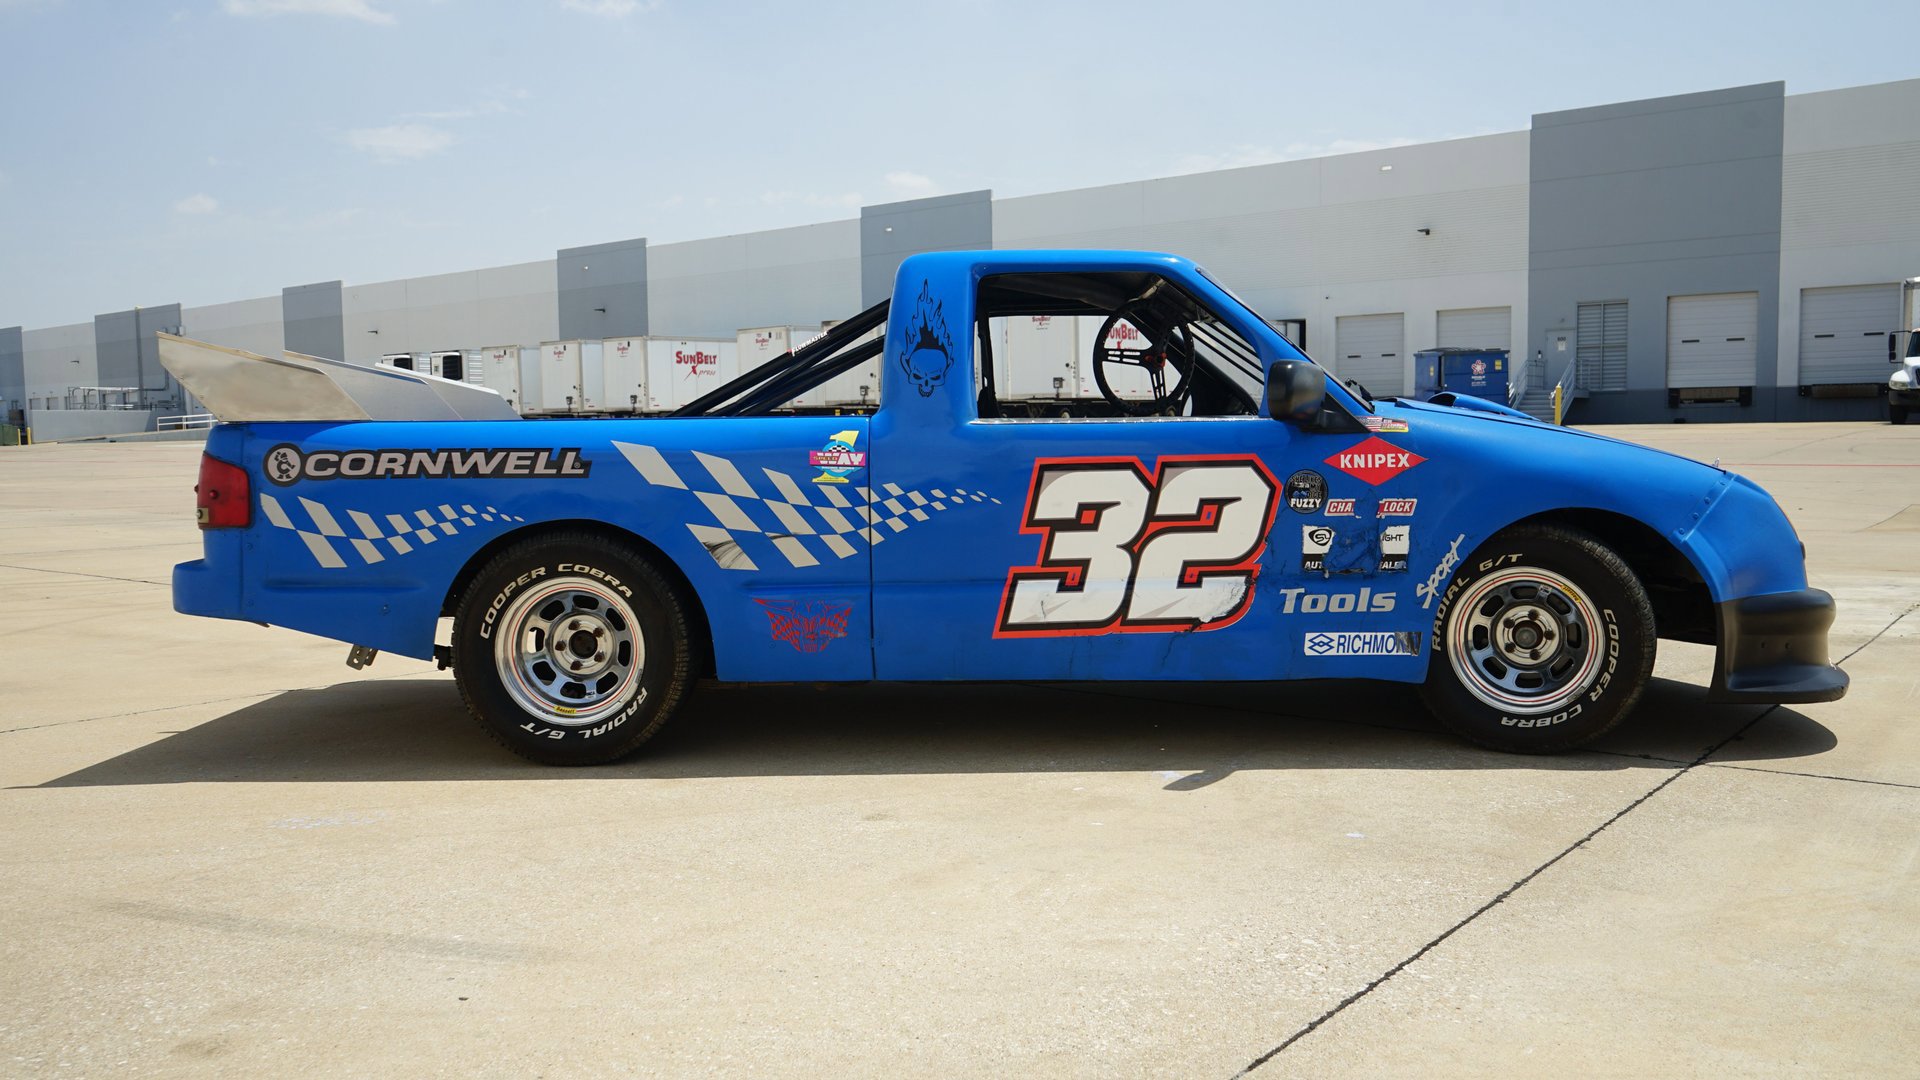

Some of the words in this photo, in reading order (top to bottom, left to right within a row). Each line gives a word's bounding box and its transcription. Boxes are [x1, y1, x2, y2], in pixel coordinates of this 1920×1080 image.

[791, 331, 828, 357] FLOWMASTER
[676, 351, 717, 365] SUNBELT
[304, 451, 585, 476] CORNWELL
[816, 452, 864, 465] WAY
[1340, 453, 1410, 469] KNIPEX
[1290, 498, 1322, 508] FUZZY
[1329, 502, 1354, 512] CHA
[1383, 501, 1412, 512] LOCK
[996, 457, 1281, 637] 32
[480, 566, 547, 640] COOPER
[557, 563, 633, 598] COBRA
[1279, 587, 1397, 614] Tools
[1431, 576, 1471, 651] RADIAL
[1478, 553, 1523, 572] G/T
[1336, 634, 1421, 654] RICHMO
[1589, 608, 1620, 702] COOPER
[577, 687, 648, 739] RADIAL
[1501, 703, 1583, 728] COBRA
[519, 722, 566, 740] G/T
